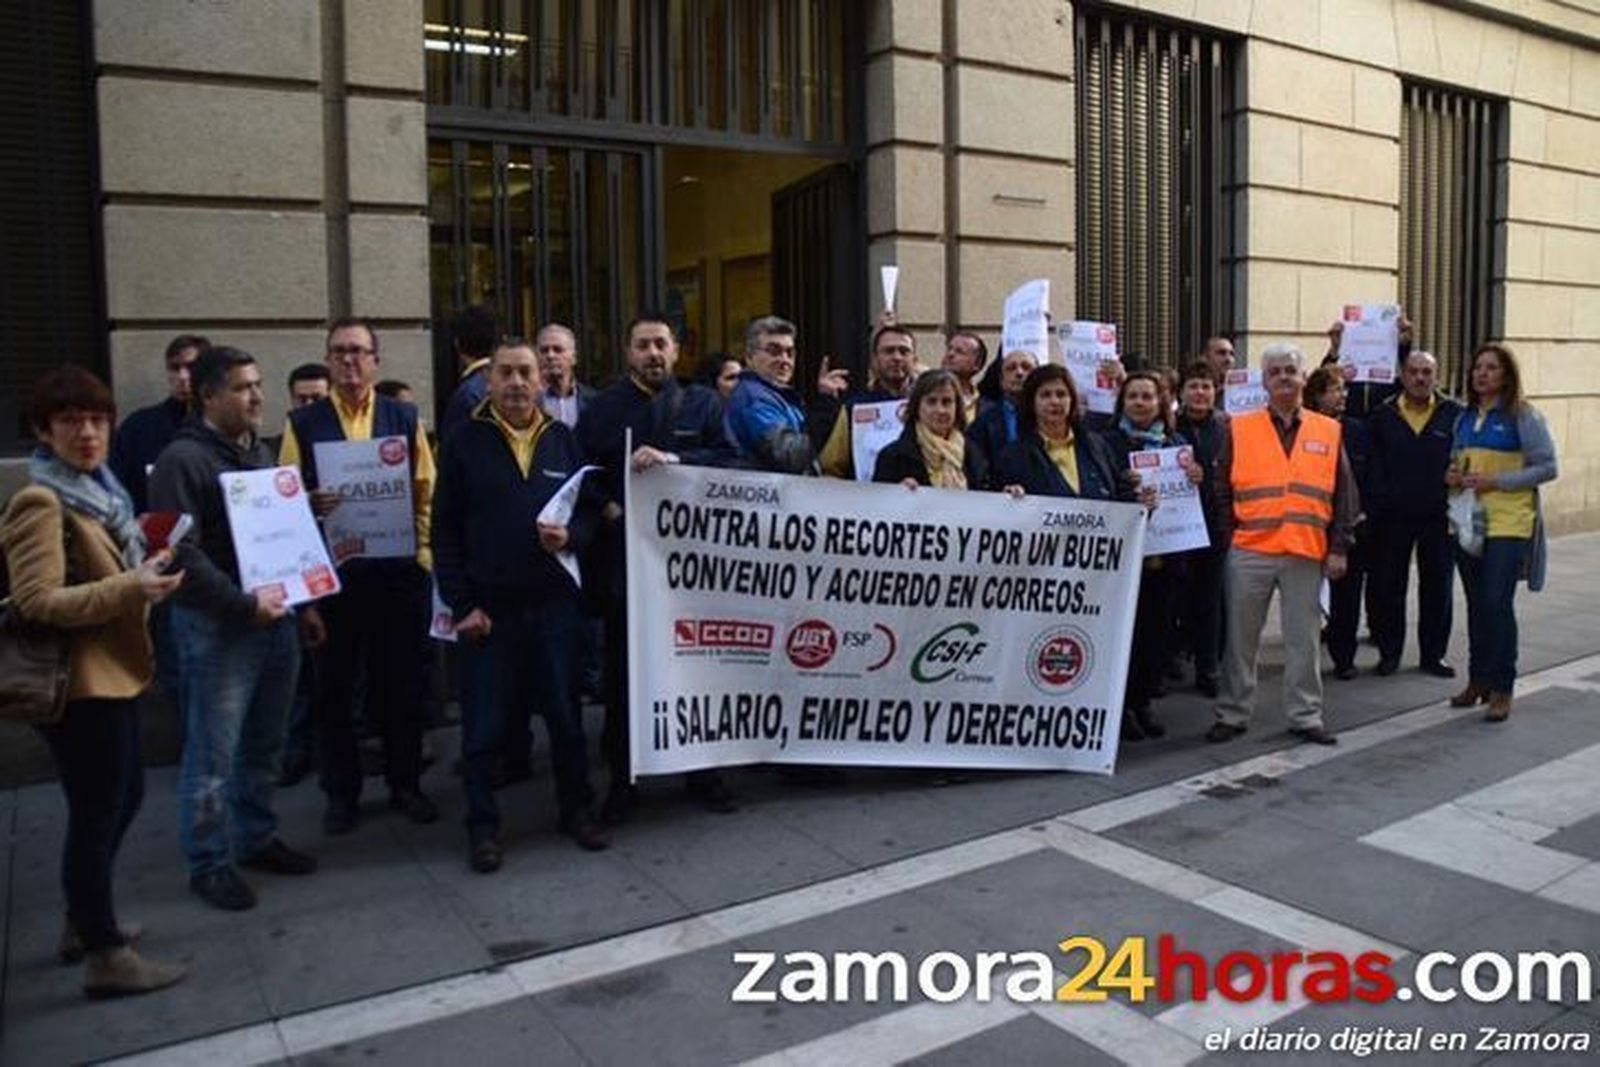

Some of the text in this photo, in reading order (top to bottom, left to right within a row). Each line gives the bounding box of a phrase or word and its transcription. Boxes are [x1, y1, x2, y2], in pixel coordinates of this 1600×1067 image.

[706, 482, 780, 504] ZAMORA
[657, 499, 1123, 571] CONTRA LOS RECORTES Y POR UN BUEN
[1043, 511, 1106, 530] ZAMORA
[667, 551, 1102, 616] CONVENIO Y ACUERDO EN CORREOS...
[843, 631, 873, 647] FSP
[676, 694, 789, 750] SALARIO,
[799, 697, 912, 743] EMPLEO
[923, 701, 942, 743] Y
[946, 702, 1106, 750] DERECHOS!!
